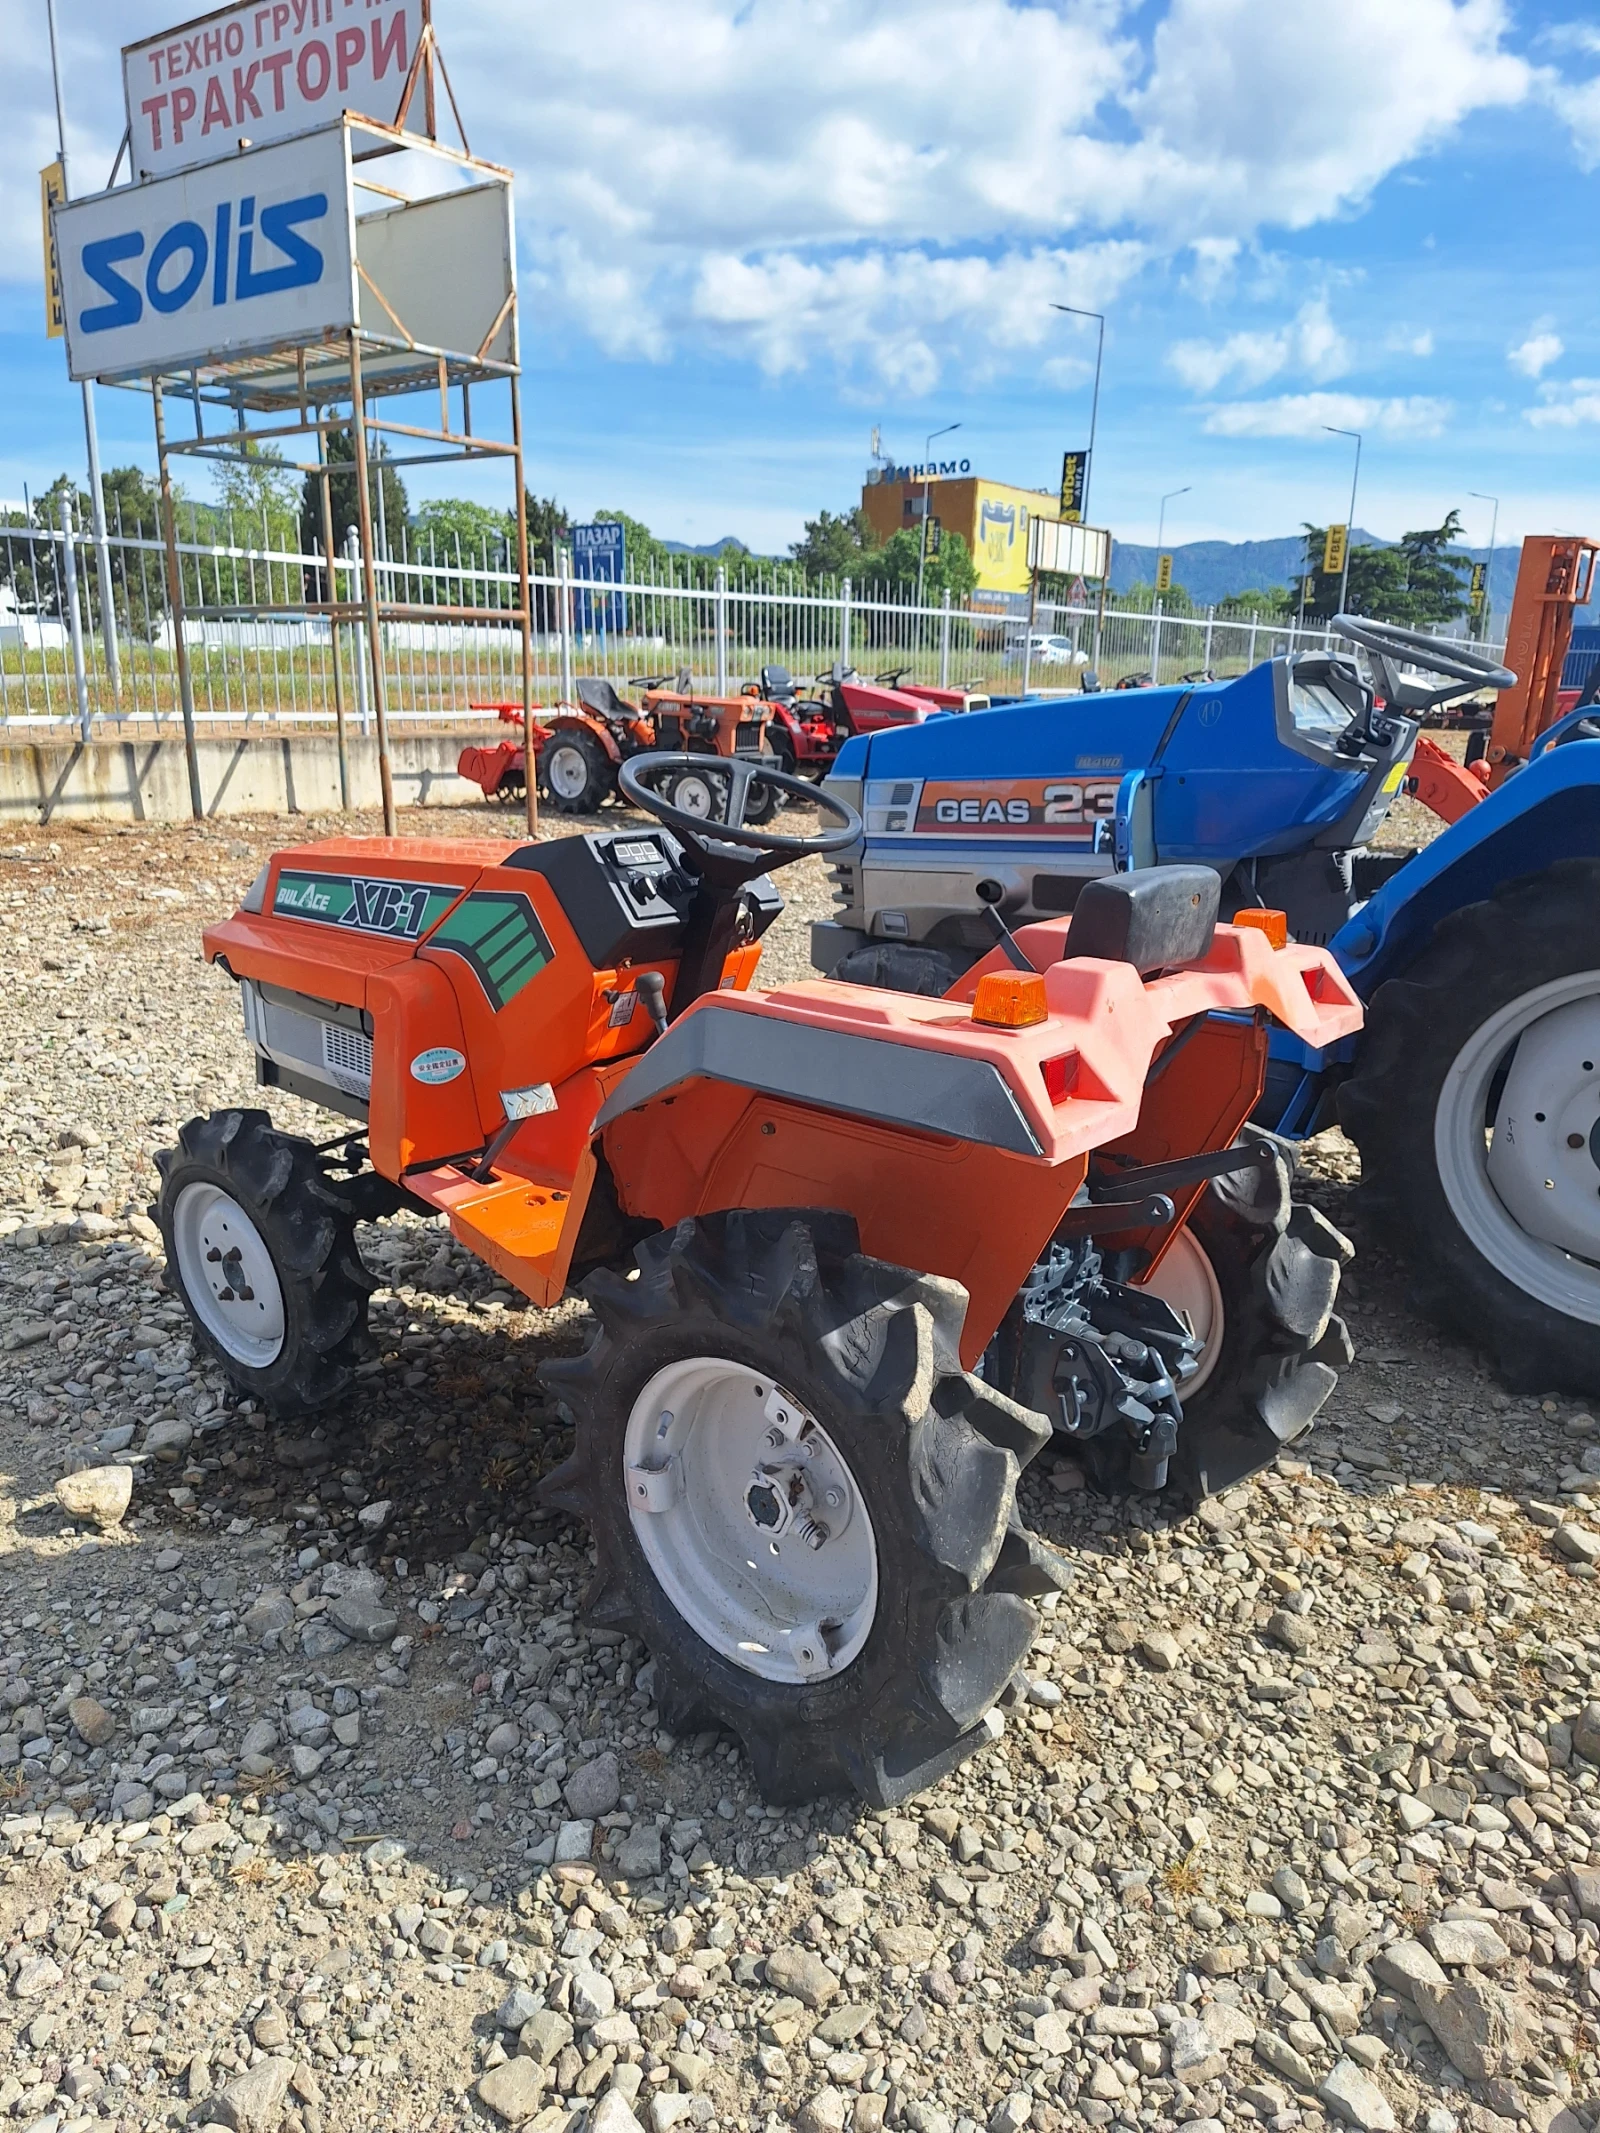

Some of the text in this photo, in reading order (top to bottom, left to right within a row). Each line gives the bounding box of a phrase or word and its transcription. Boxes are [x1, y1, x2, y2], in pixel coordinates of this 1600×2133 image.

[148, 22, 244, 85] ТЕХНО
[141, 9, 408, 152] ТРАКТОРИ
[575, 526, 621, 546] ПАЗАР
[1329, 527, 1343, 569] EFBET
[936, 782, 1120, 824] GEAS 23
[277, 879, 431, 935] BULACE XB-1
